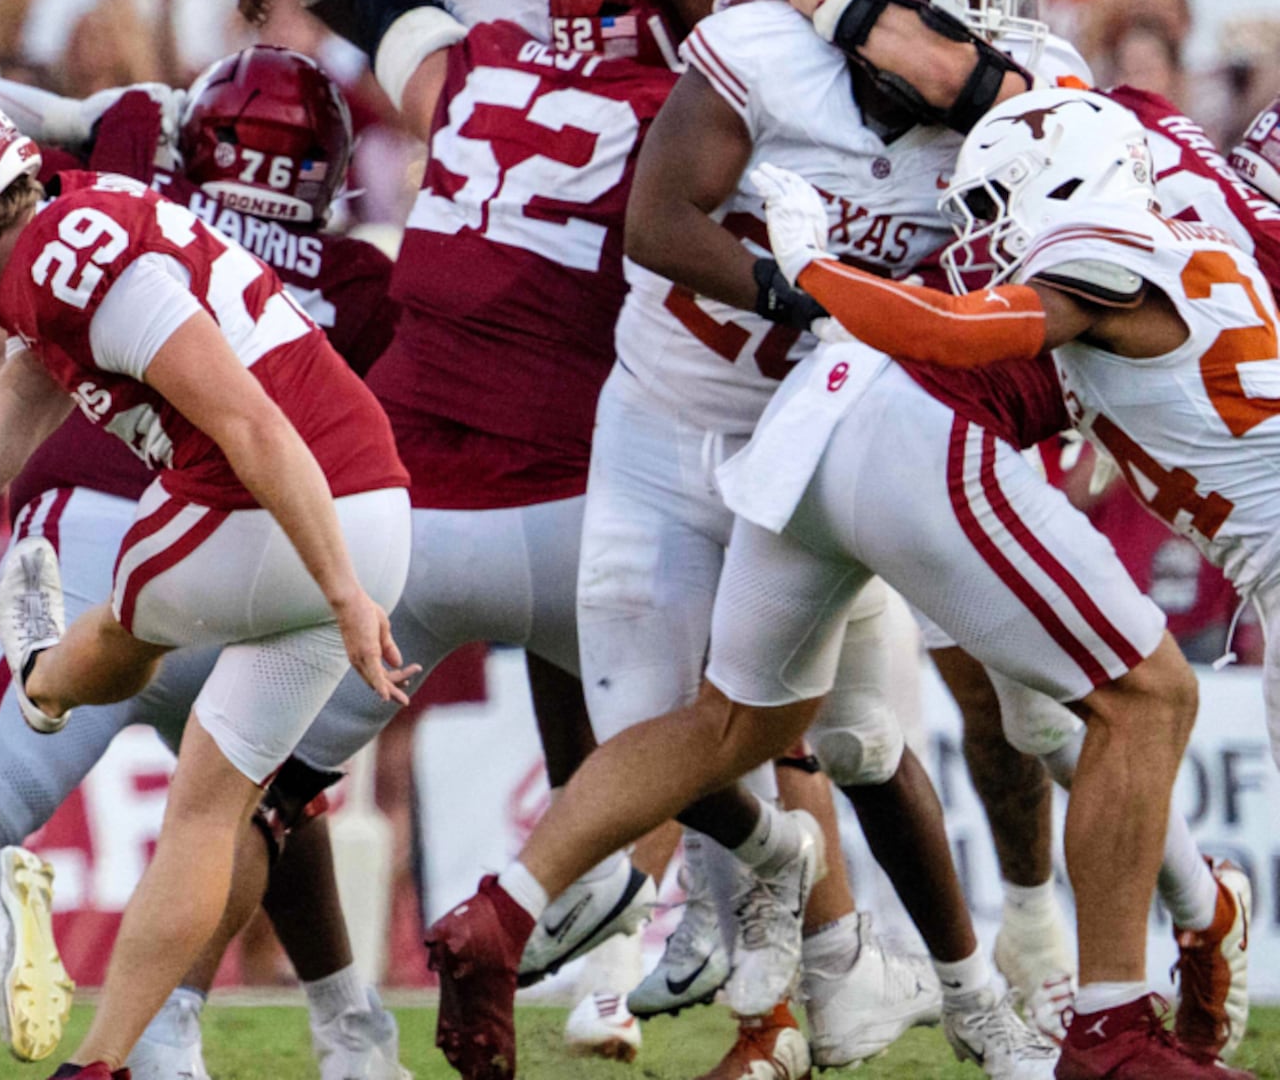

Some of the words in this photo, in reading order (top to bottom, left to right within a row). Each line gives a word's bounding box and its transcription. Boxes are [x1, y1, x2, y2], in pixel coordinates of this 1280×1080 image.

[553, 17, 595, 52] 52
[240, 148, 294, 190] 76
[405, 65, 641, 273] 52
[32, 206, 130, 309] 29
[188, 192, 323, 278] HARRIS
[810, 182, 919, 264] XAS
